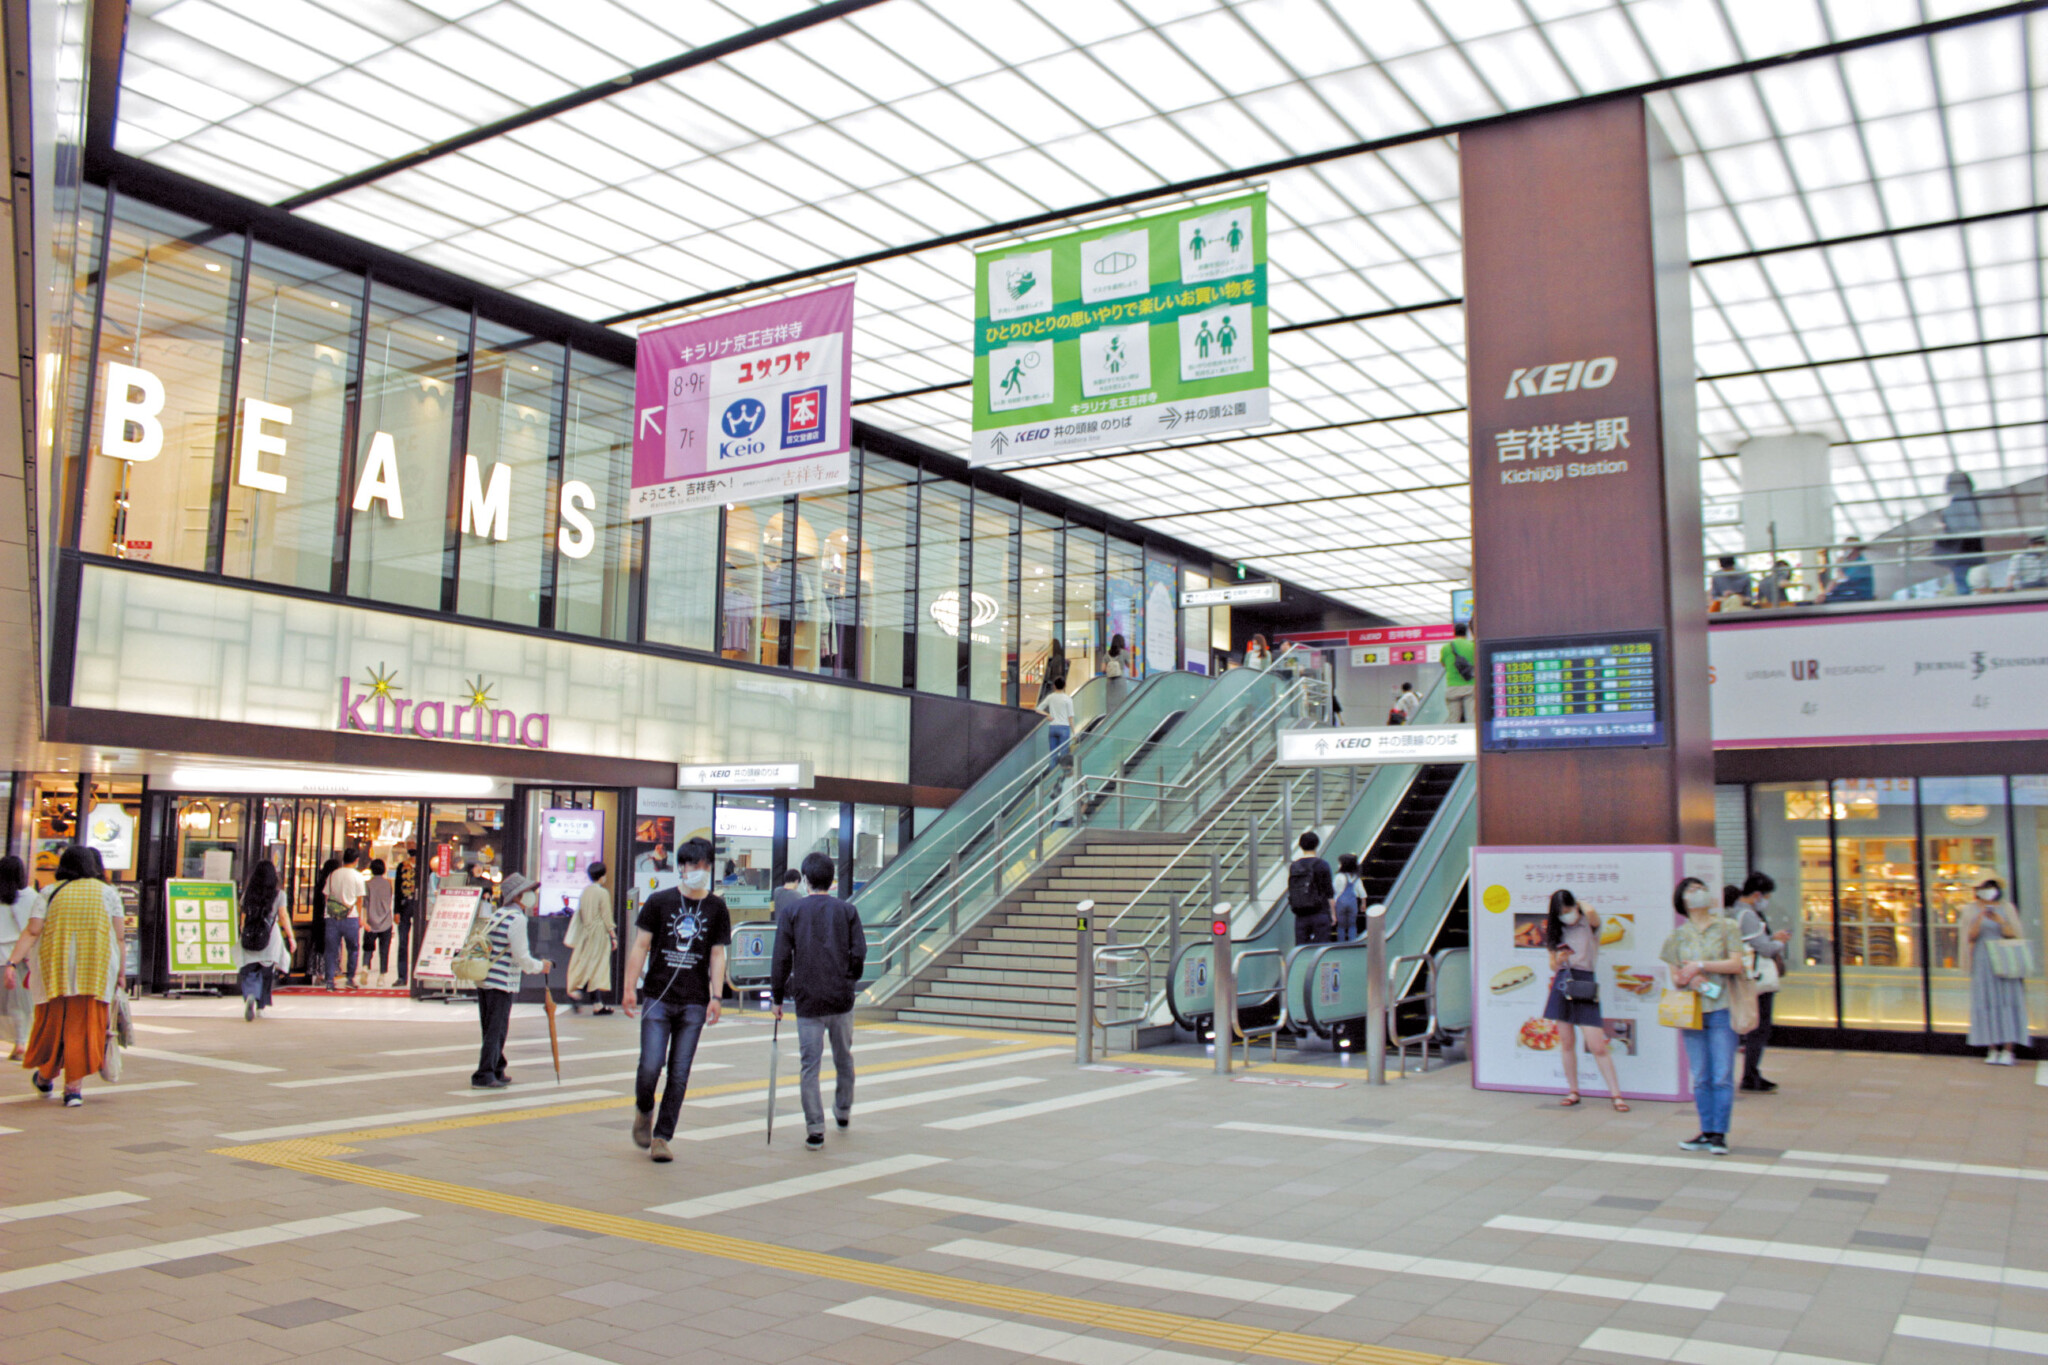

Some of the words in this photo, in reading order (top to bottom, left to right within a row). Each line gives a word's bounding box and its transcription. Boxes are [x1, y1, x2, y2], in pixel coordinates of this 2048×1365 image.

[986, 279, 1256, 343] ひとりひとりの思いやりで楽しいお買い物を
[680, 321, 803, 363] キラリナ京王吉祥寺
[1504, 356, 1618, 399] KEIO
[793, 397, 816, 426] 本
[1184, 402, 1247, 423] 井の頭公園
[680, 428, 695, 450] 7F
[1015, 427, 1050, 443] KEIO
[1101, 415, 1132, 430] のりば
[1494, 416, 1631, 463] 吉祥寺駅
[719, 438, 765, 460] Keio
[1566, 459, 1628, 478] Station
[1790, 659, 1819, 681] UR
[338, 676, 549, 748] kirarina
[1335, 737, 1371, 749] KEIO
